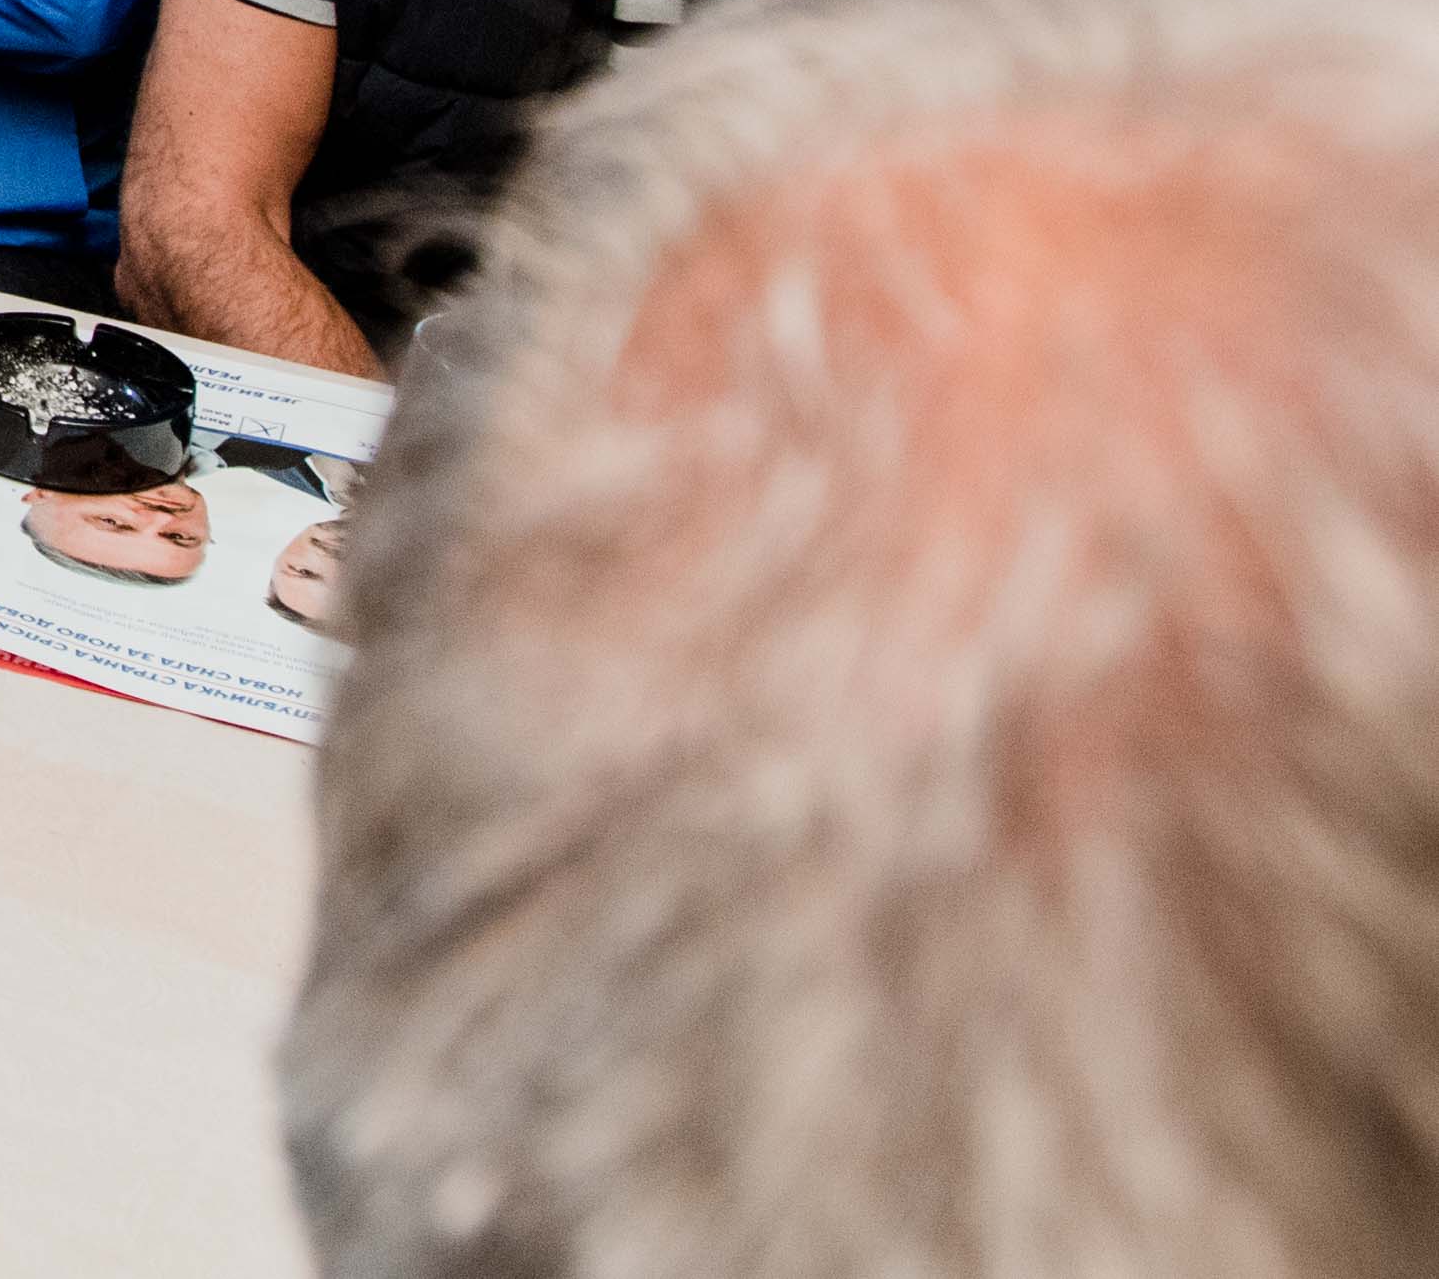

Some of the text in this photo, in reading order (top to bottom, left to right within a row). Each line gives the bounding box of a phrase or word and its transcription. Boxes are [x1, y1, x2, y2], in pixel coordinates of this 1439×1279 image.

[57, 625, 124, 654] НОВО
[74, 648, 177, 686] СТРАНКА
[127, 647, 153, 662] ЗА
[151, 656, 233, 682] СНАГА
[238, 676, 304, 700] НОВА
